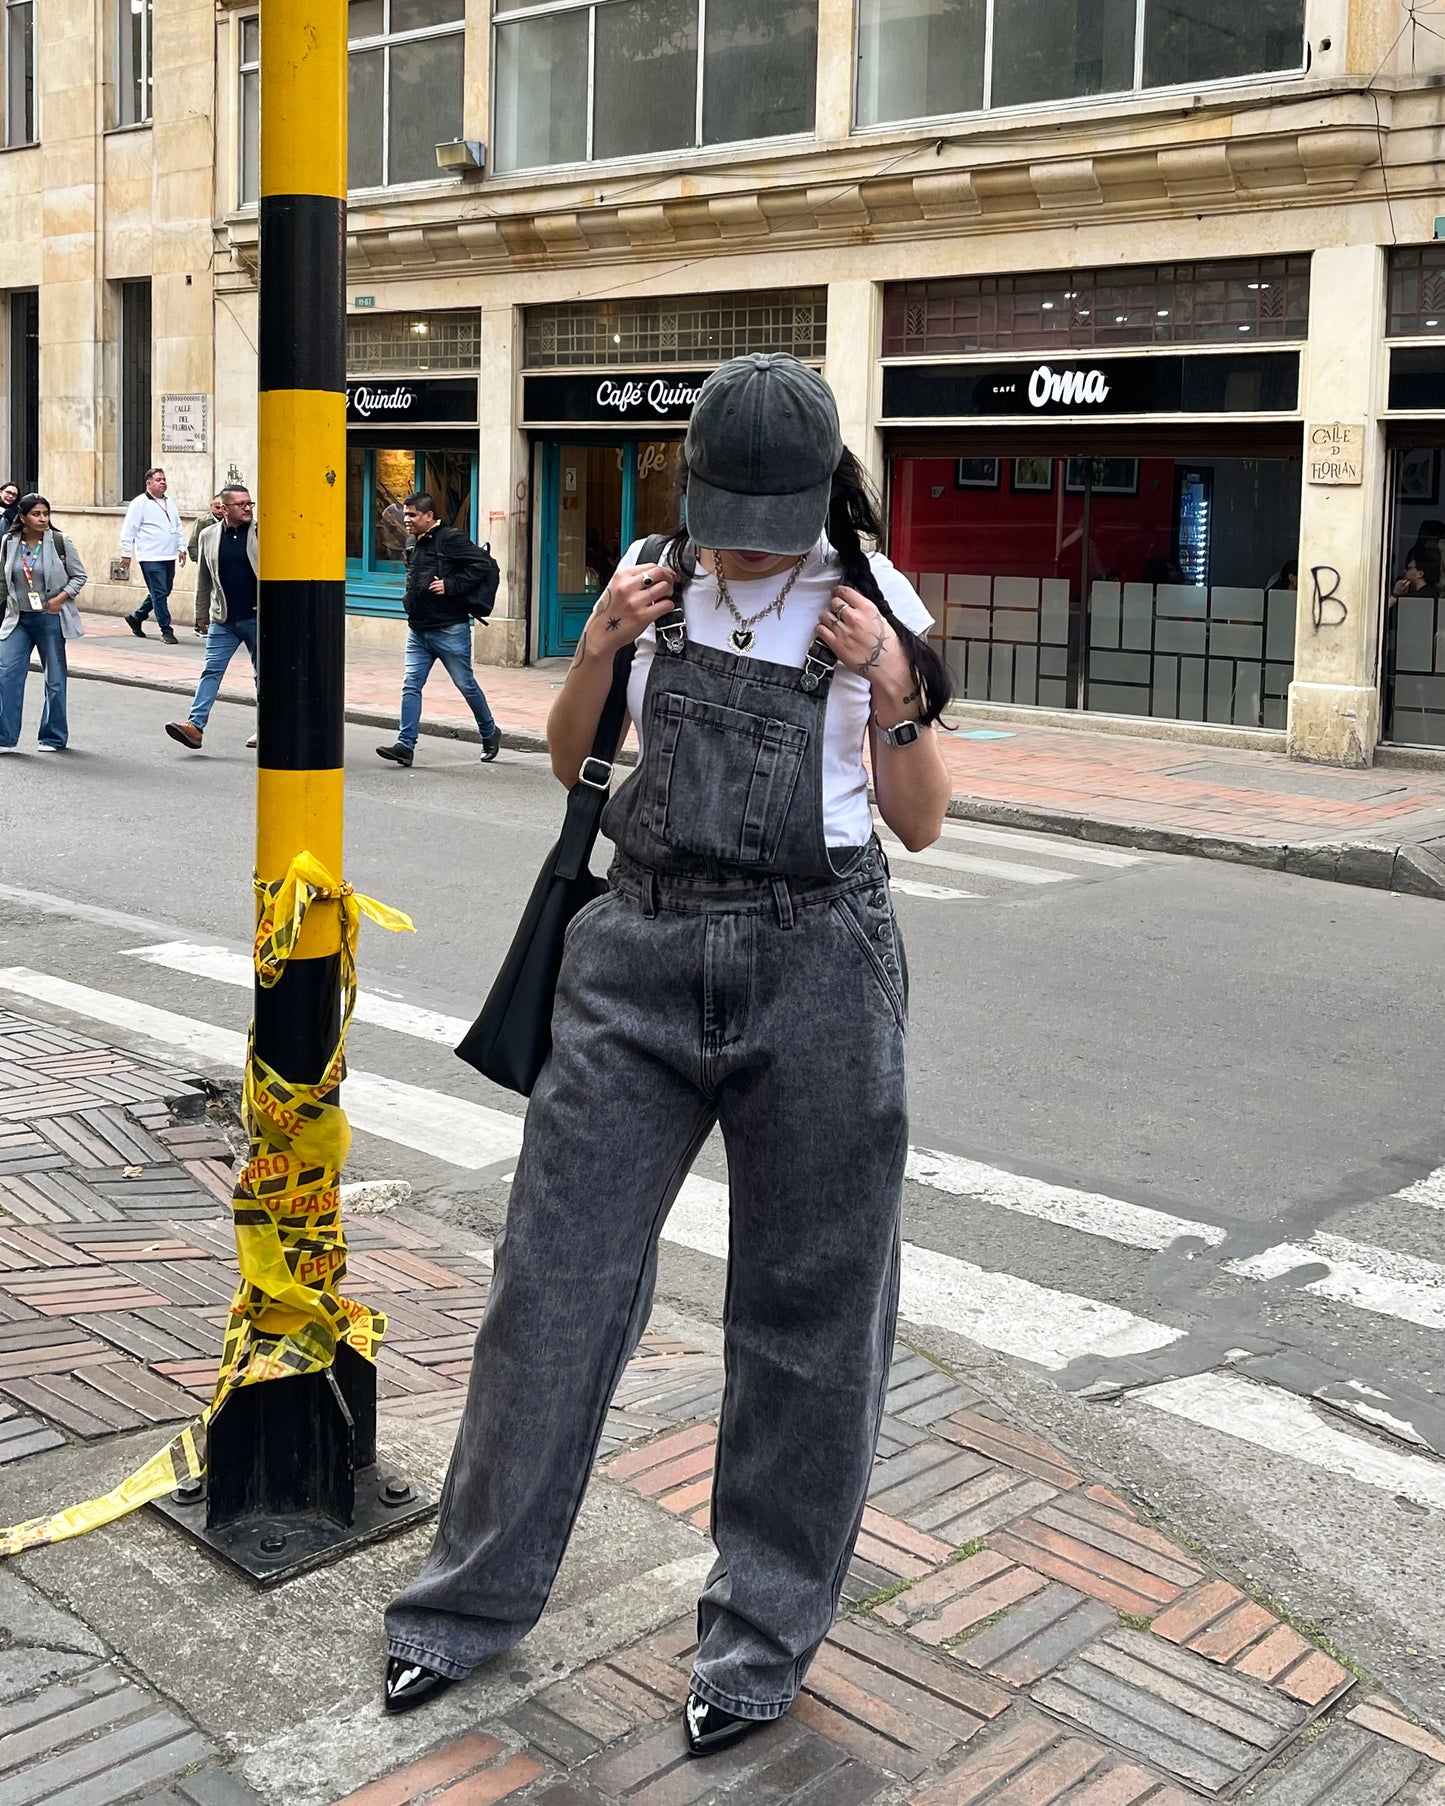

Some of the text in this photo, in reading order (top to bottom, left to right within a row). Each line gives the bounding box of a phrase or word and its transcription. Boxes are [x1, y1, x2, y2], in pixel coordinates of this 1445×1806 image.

[354, 386, 412, 417] Quindío
[596, 380, 643, 412] Café
[993, 365, 1110, 408] CAFÉ Oma
[174, 405, 191, 413] CALLE
[179, 415, 188, 423] DEL
[1312, 426, 1351, 445] CALLE
[1311, 461, 1356, 480] FLORIAN
[1311, 566, 1348, 635] B
[257, 1093, 308, 1137] PASE
